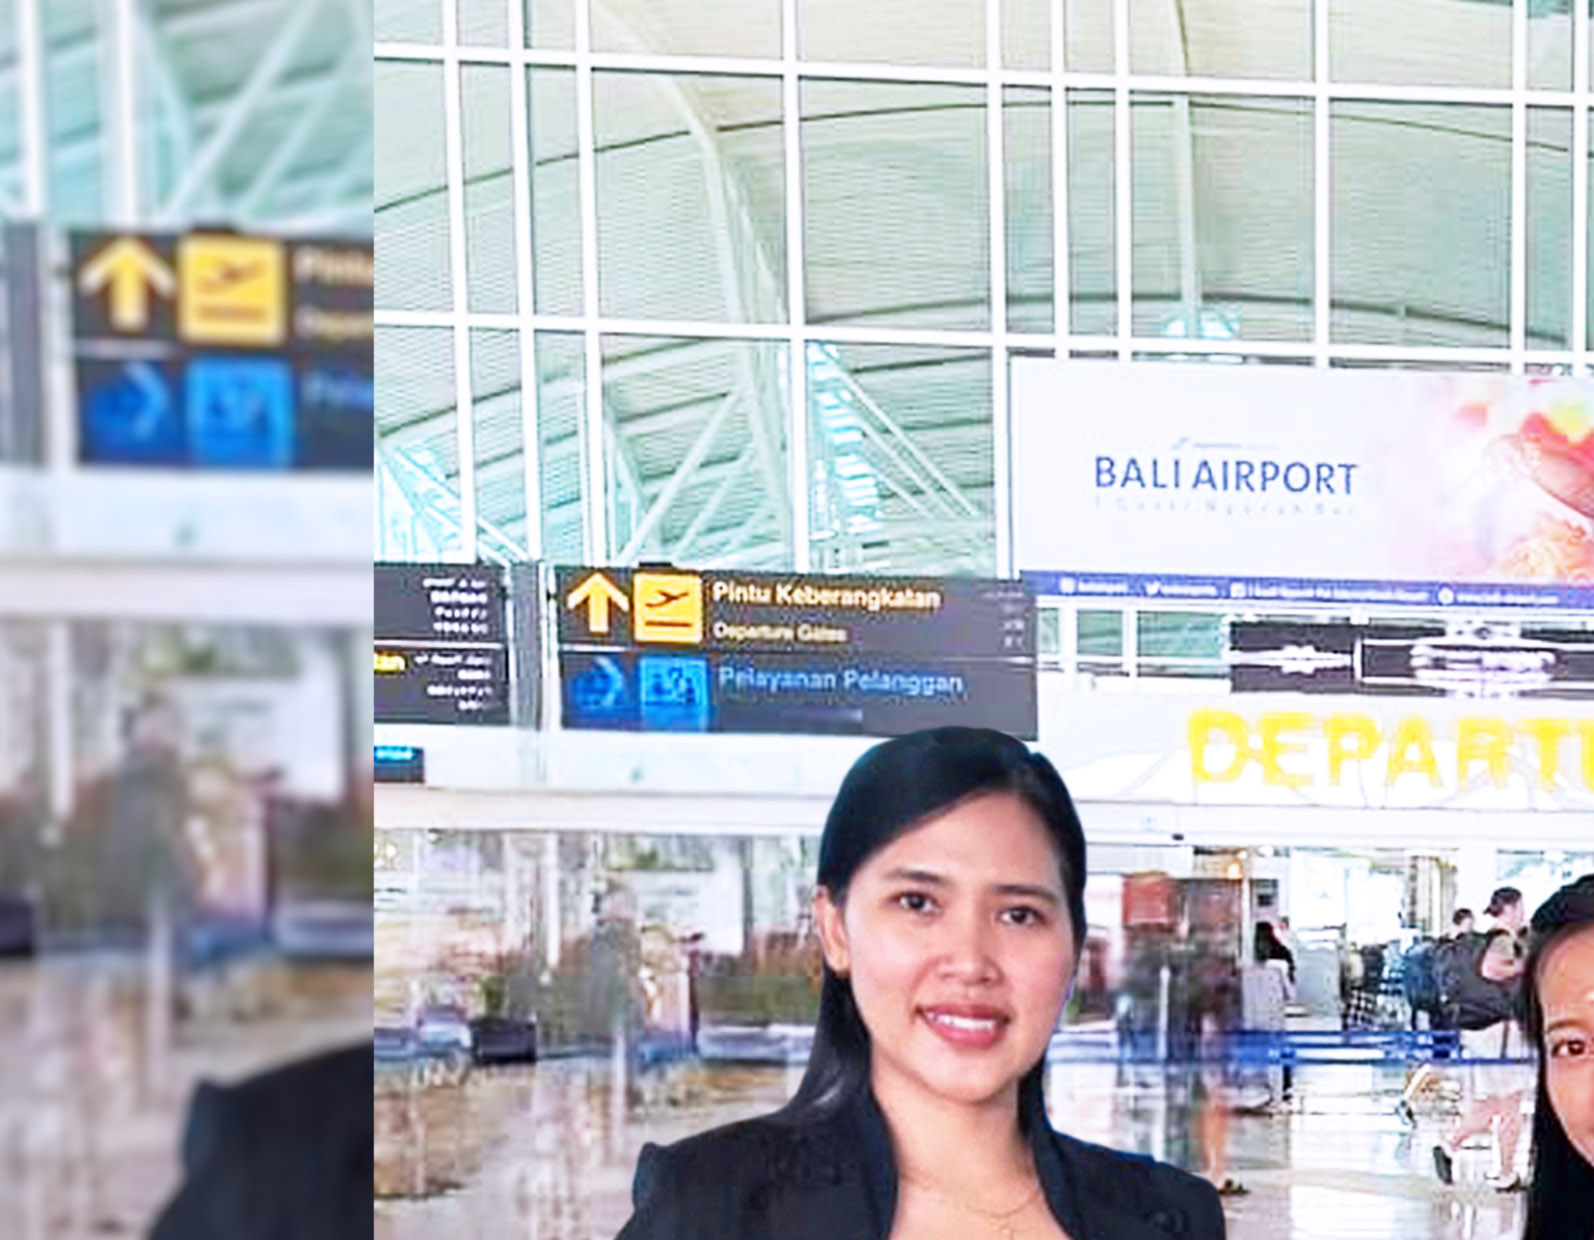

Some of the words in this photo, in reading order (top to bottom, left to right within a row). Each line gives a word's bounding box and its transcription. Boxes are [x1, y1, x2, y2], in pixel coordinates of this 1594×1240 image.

[1095, 455, 1179, 489] BALI
[1191, 459, 1359, 495] AIRPORT
[712, 580, 771, 604] Pintu
[775, 583, 942, 611] Keberangkatan
[719, 666, 836, 691] Pelayanan
[844, 671, 963, 697] Pelanggan
